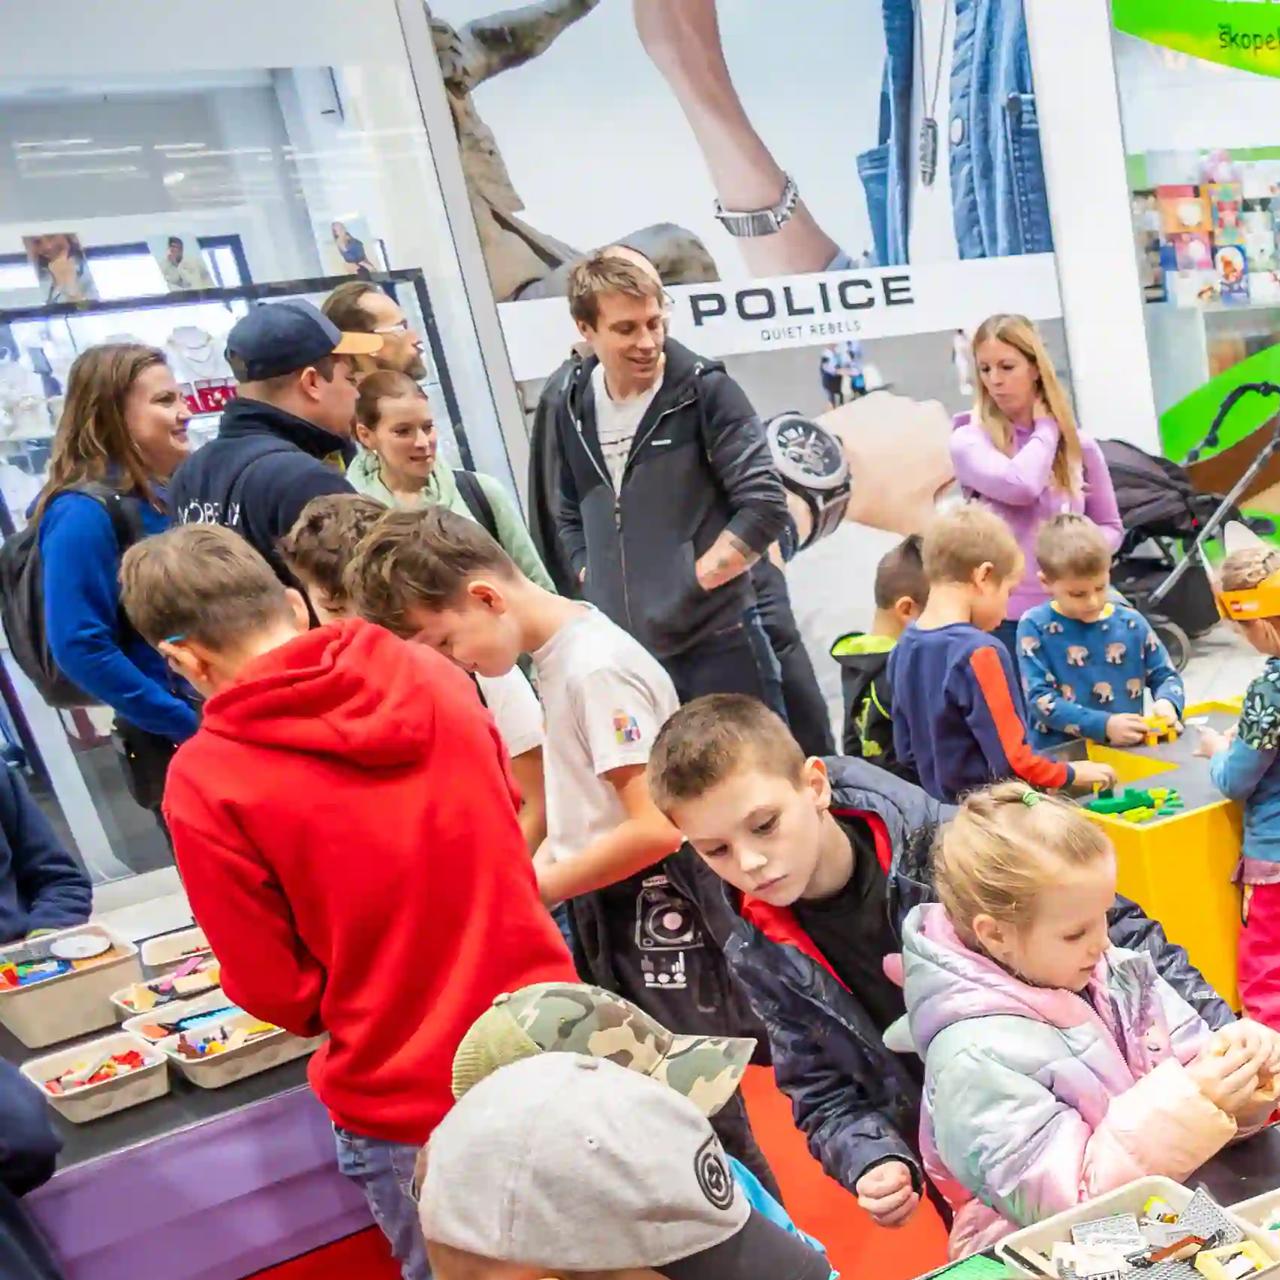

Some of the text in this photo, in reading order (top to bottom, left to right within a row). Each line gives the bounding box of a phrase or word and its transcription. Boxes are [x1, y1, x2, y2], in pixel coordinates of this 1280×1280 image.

[689, 275, 914, 327] POLICE
[760, 320, 862, 342] QUIET REBELS
